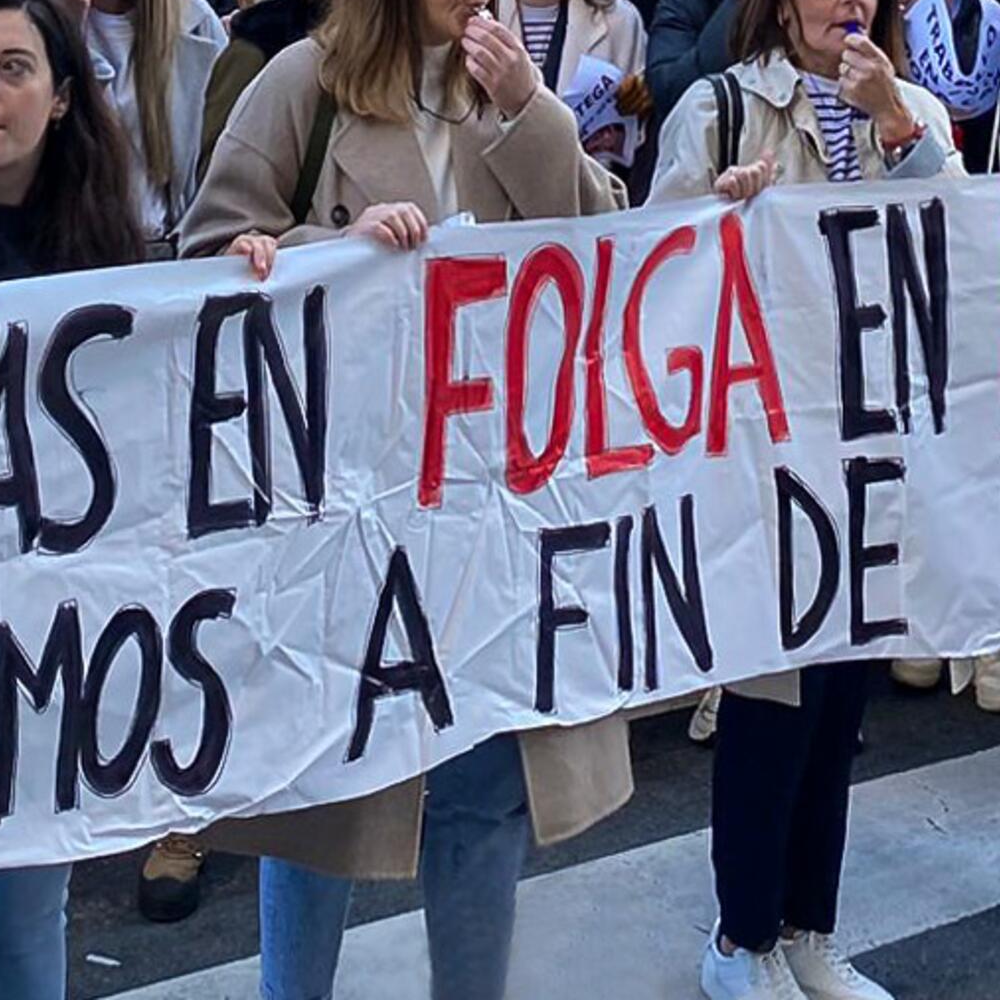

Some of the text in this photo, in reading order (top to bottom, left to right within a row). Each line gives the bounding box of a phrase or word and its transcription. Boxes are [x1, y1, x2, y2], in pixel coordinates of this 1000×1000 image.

[187, 285, 328, 537] EN
[416, 212, 791, 508] FOLGA
[818, 197, 950, 441] EN
[344, 544, 455, 764] A
[534, 494, 714, 714] FIN
[773, 455, 910, 651] DE
